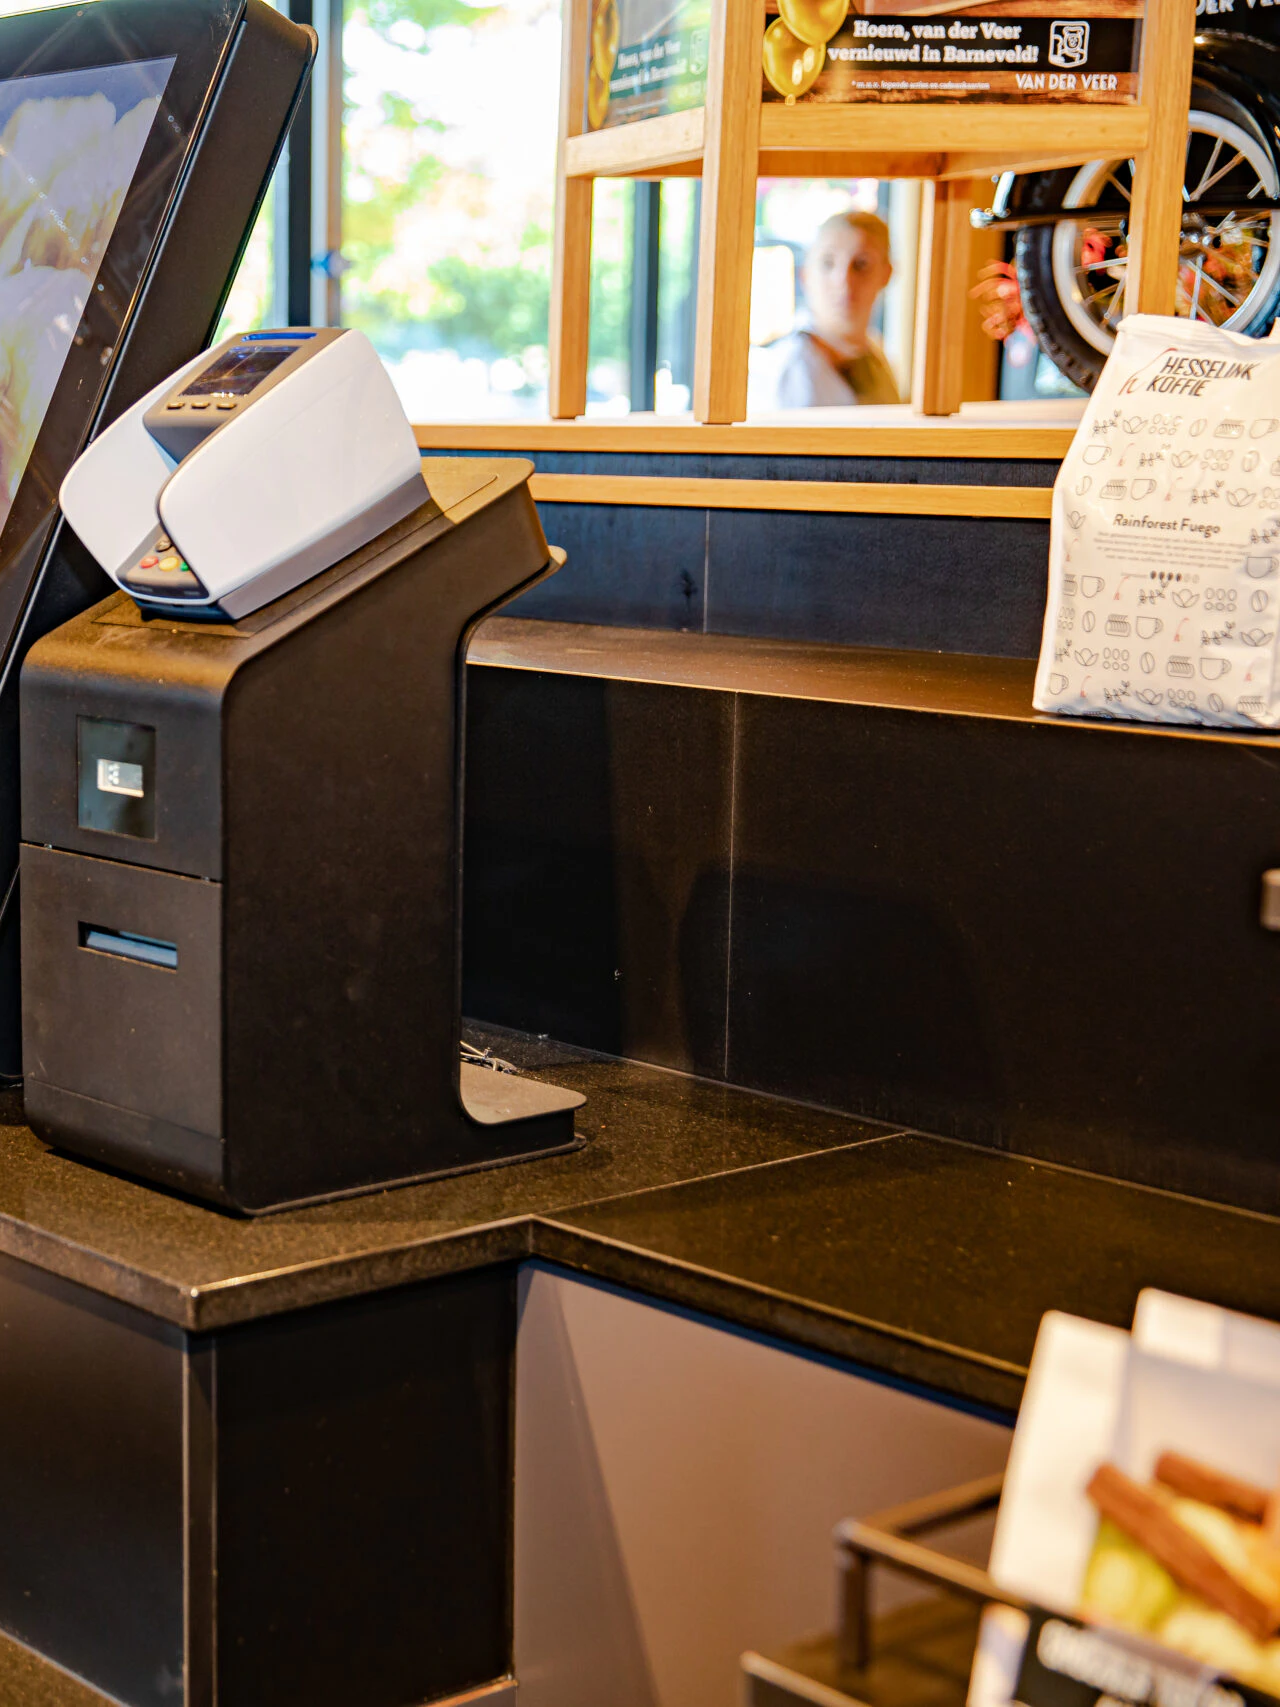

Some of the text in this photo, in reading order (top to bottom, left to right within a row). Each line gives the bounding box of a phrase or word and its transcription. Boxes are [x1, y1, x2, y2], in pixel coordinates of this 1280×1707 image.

[853, 20, 1022, 41] Hoera, van der Veer
[827, 43, 1039, 63] vernieuwd in Barneveld!
[1015, 73, 1118, 91] VAN DER VEER
[1160, 355, 1261, 381] HESSELINK
[1146, 375, 1211, 397] KOFFIE
[1113, 513, 1221, 538] Rainforest Fuego
